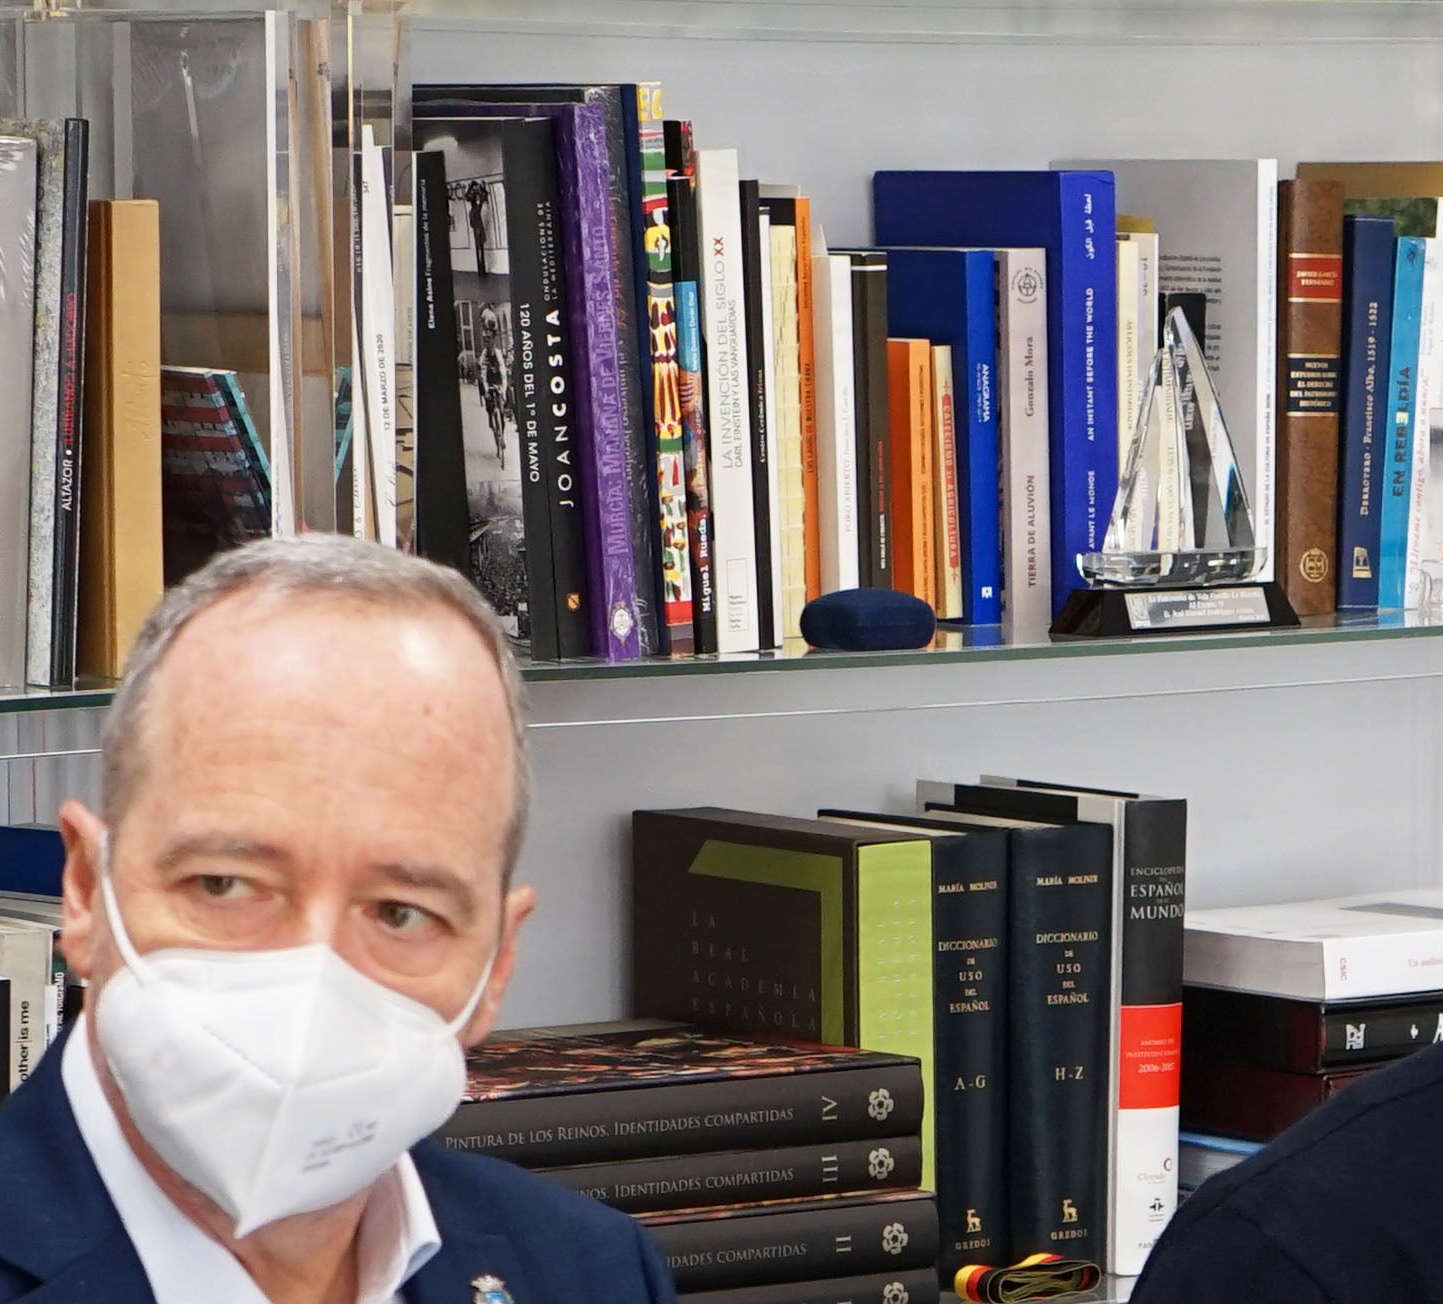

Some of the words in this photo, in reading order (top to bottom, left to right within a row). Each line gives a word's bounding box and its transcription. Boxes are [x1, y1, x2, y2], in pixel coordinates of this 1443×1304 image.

[591, 225, 607, 284] SANTO
[714, 236, 725, 256] XX
[714, 260, 726, 310] SIGLO
[519, 303, 531, 326] 120
[1085, 288, 1094, 323] WORLD
[1369, 302, 1378, 326] 1522
[595, 290, 618, 358] VIERNES
[717, 316, 728, 345] DEL
[1086, 325, 1094, 344] THE
[375, 333, 384, 353] 2020
[520, 329, 533, 370] AÑOS
[1024, 336, 1034, 367] Mora
[1367, 336, 1377, 362] 1519
[377, 356, 387, 369] DE
[546, 310, 567, 417] COSTA
[601, 363, 617, 388] DE
[1086, 346, 1094, 383] BEFORE
[378, 370, 389, 405] MARZO
[523, 374, 535, 398] DEL
[1365, 365, 1376, 392] Albo,
[716, 351, 732, 445] INVENCIÓN
[981, 363, 991, 423] ANAGRAMA
[1024, 370, 1035, 417] Gonzalo
[1086, 385, 1094, 425] INSTANT
[381, 405, 390, 419] DE
[382, 419, 390, 432] 12
[1362, 395, 1375, 443] Francisco
[526, 421, 538, 438] DE
[600, 394, 624, 474] MAÑANA
[1087, 427, 1095, 441] AN
[528, 442, 540, 483] MAYO
[553, 425, 574, 508] JOAN
[722, 449, 733, 468] LA
[61, 458, 74, 511] ALTAZOR
[1087, 470, 1095, 504] MONDE
[1360, 452, 1372, 515] DERROTERO
[1392, 470, 1406, 497] EN
[1025, 475, 1036, 526] ALUVIÓN
[1087, 507, 1095, 518] LE
[605, 479, 628, 555] MURCIA:
[698, 514, 708, 558] Rueda.
[1027, 528, 1036, 544] DE
[1088, 520, 1096, 549] AVANT
[1027, 546, 1037, 588] TIERRA
[701, 565, 712, 612] Miguel
[938, 882, 965, 893] MARÍA
[969, 880, 997, 891] MOLINER
[1036, 874, 1063, 887] MARÍA
[1067, 874, 1099, 884] MOLINER
[1129, 903, 1184, 920] MUNDO
[938, 937, 998, 952] DICCIONARIO
[1036, 930, 1099, 945] DICCIONARIO
[958, 971, 982, 982] USO
[1056, 963, 1081, 974] USO
[949, 1000, 990, 1014] ESPAÑOL
[1046, 992, 1090, 1006] ESPAÑOL
[821, 1095, 838, 1121] IV
[444, 1133, 505, 1151] PINTURA
[507, 1131, 526, 1146] DE
[528, 1128, 554, 1144] LOS
[557, 1123, 610, 1142] REINOS.
[613, 1115, 702, 1138] IDENTIDADES
[704, 1107, 794, 1128] COMPARTIDAS
[821, 1155, 838, 1183] III
[834, 1234, 852, 1254] II
[955, 1238, 991, 1251] GREDOS
[1050, 1228, 1088, 1241] GREDOS
